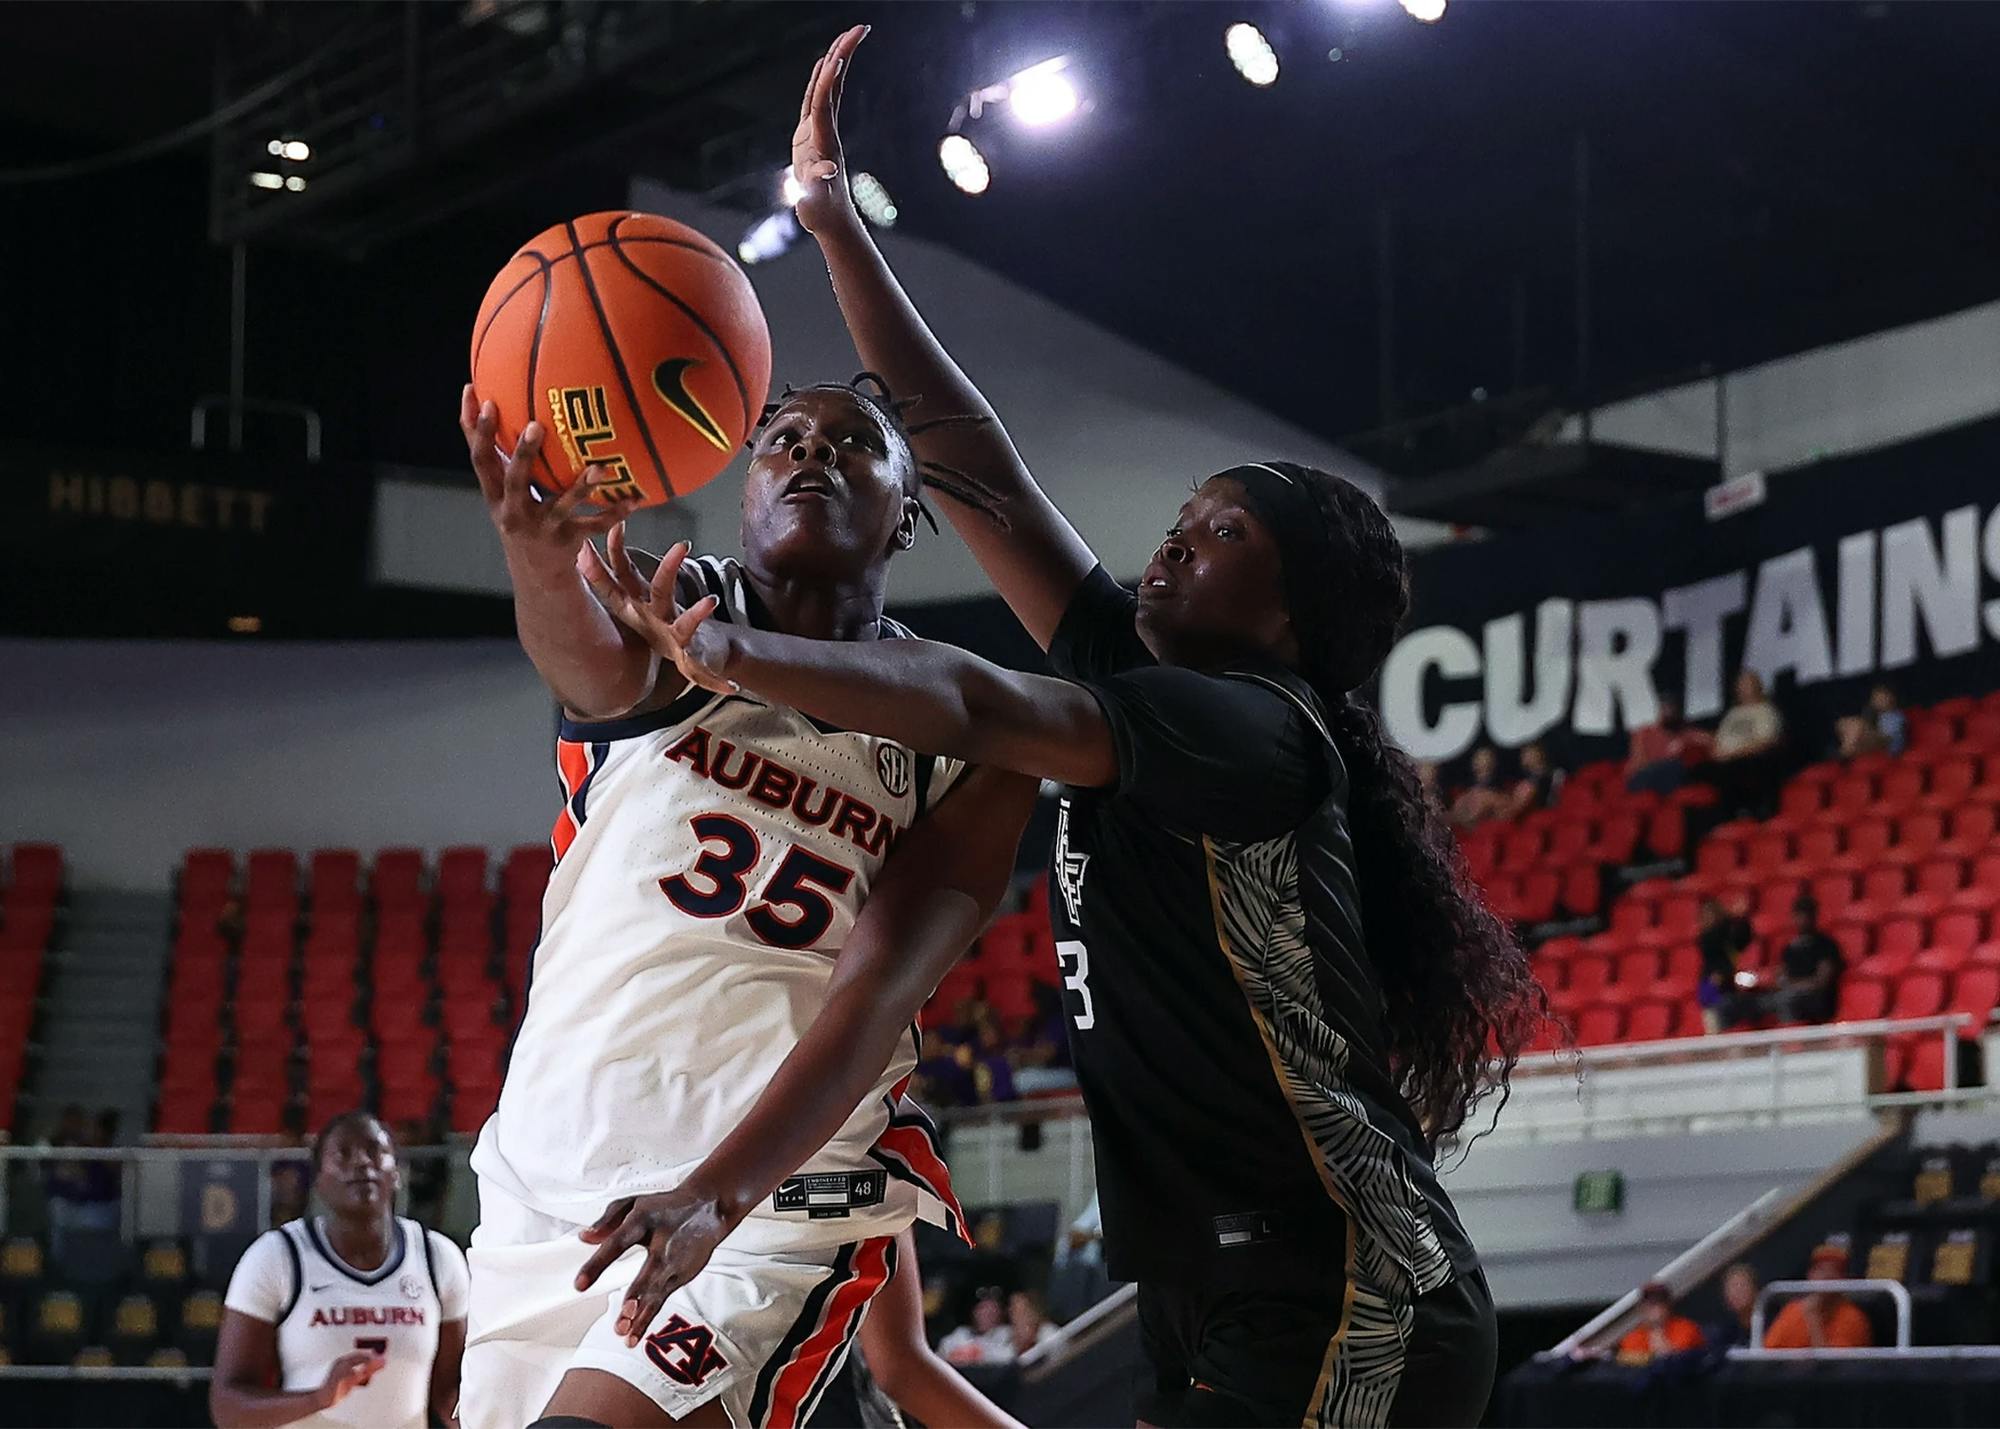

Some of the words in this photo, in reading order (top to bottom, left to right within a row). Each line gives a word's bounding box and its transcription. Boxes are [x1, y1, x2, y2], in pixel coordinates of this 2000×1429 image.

[664, 725, 903, 856] AUBURN
[658, 811, 855, 949] 35
[855, 1181, 871, 1195] 48
[309, 1306, 425, 1327] AUBURN
